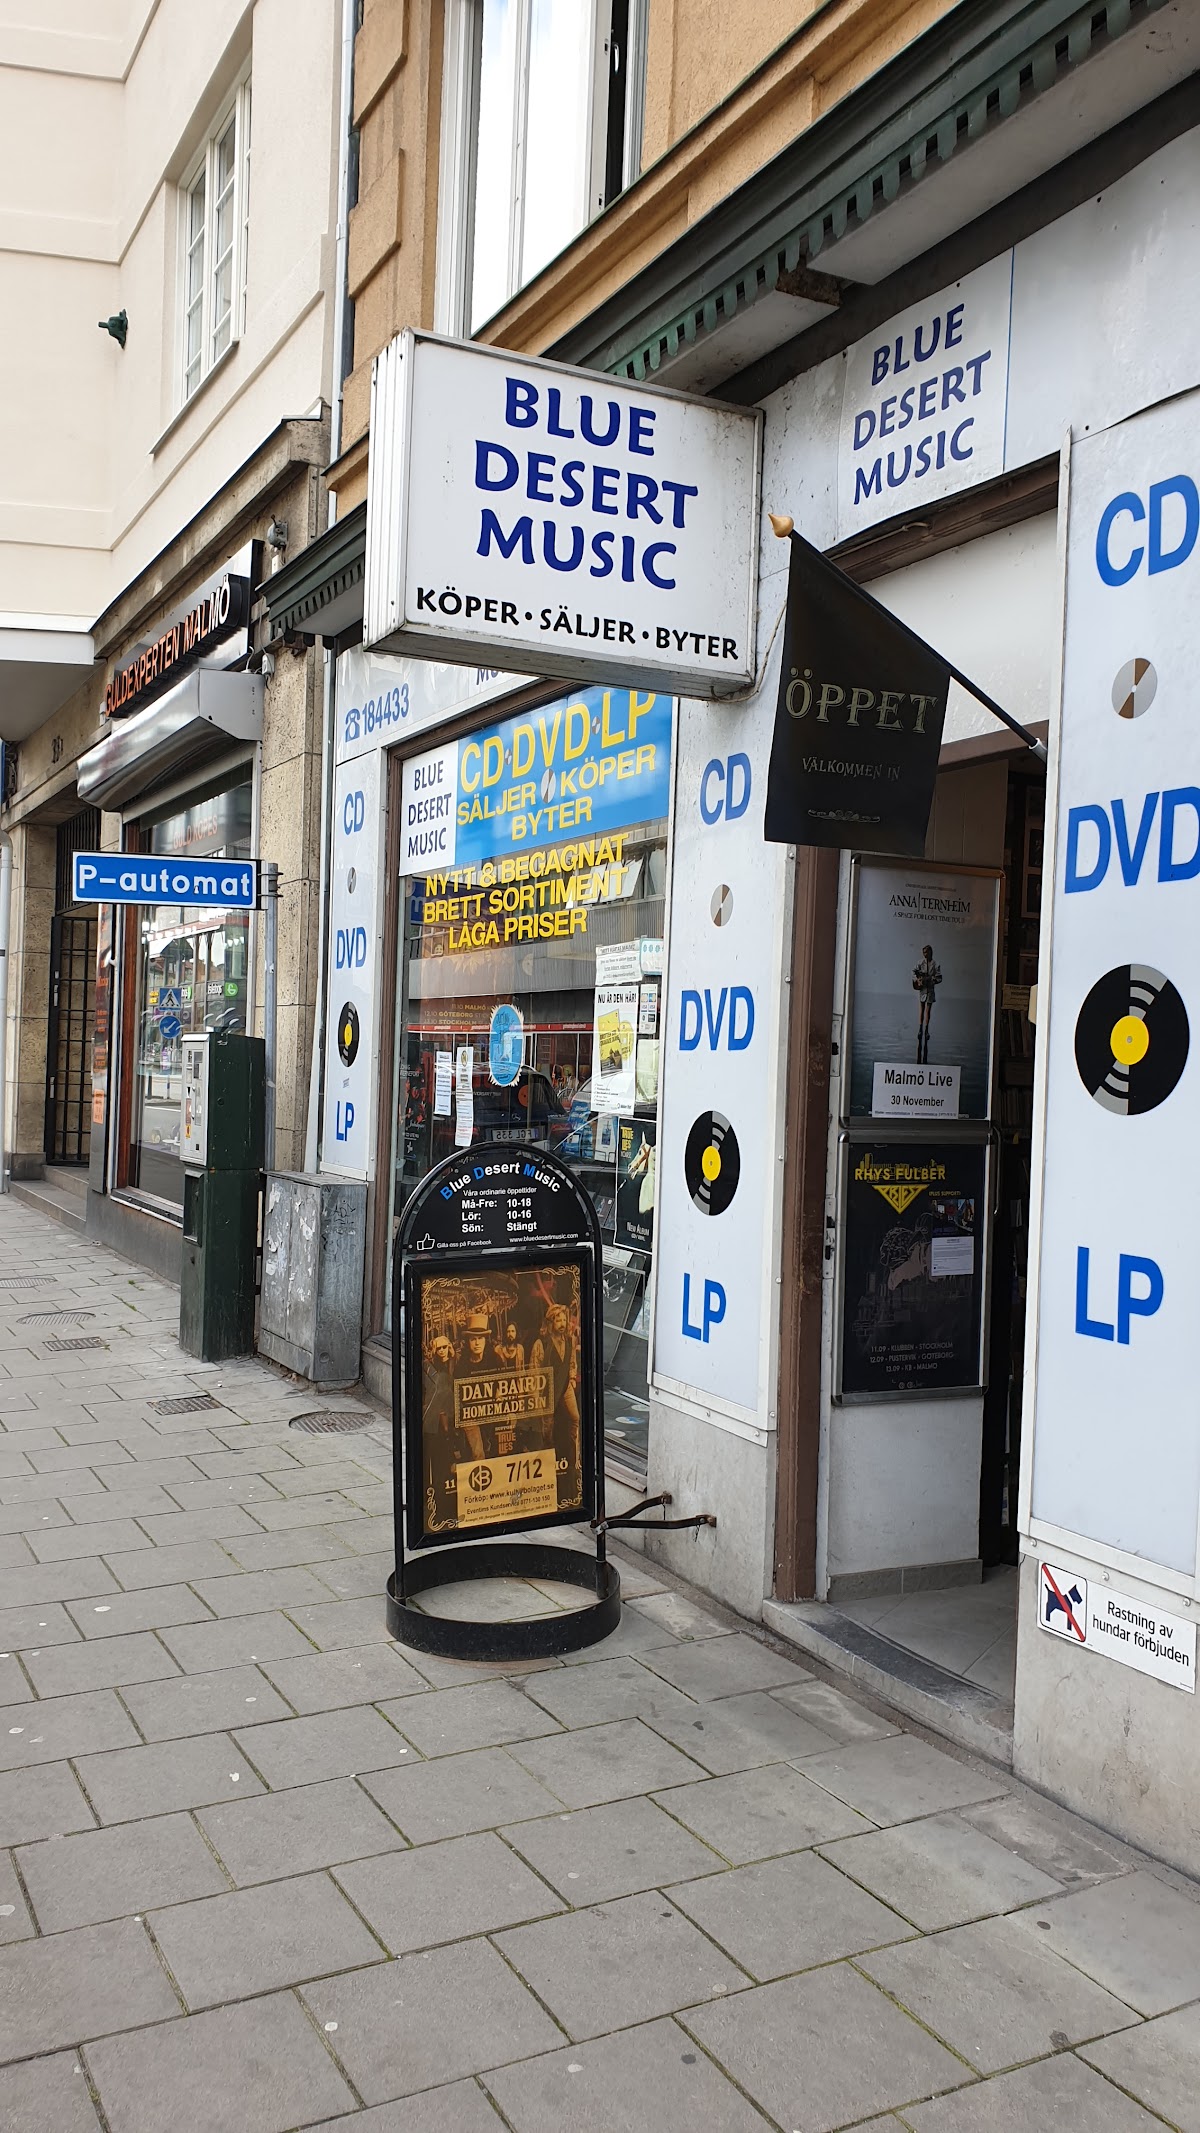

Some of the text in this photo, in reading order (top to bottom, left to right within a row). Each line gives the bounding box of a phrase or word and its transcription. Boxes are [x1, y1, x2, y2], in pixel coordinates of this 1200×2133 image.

[871, 303, 965, 386] BLUE
[505, 377, 656, 456] BLUE
[853, 350, 991, 451] DESERT
[853, 417, 975, 505] MUSIC
[475, 439, 698, 529] DESERT
[476, 509, 677, 590] MUSIC
[1096, 474, 1199, 587] CD
[416, 586, 739, 660] KÖPER SÄLJER BYTER
[105, 573, 231, 717] GULDEXPERTEN MALMÖ
[362, 682, 410, 736] 184433
[785, 667, 937, 734] ÖPPET
[461, 690, 656, 793] CD DVD LP
[413, 760, 444, 791] BLUE
[457, 744, 656, 826] SÄLJER KÖPER
[700, 752, 752, 826] CD
[802, 756, 900, 781] VÄLKOMMEN IN
[343, 790, 365, 836] CD
[408, 793, 451, 826] DESERT
[512, 796, 593, 840] BYTER
[408, 828, 447, 857] MUSIC
[1064, 786, 1200, 894] DVD
[79, 864, 250, 897] P-automat
[426, 834, 629, 897] NYTT & BEGAGNAT
[424, 867, 629, 923] BRETT SORTIMENT
[889, 894, 971, 913] ANNA TERNHEIM
[336, 926, 367, 970] DVD
[449, 908, 588, 948] LÅGA PRISER
[597, 993, 606, 1003] NU
[613, 993, 624, 1003] DEN
[678, 986, 755, 1052] DVD
[884, 1069, 953, 1087] Malmö Live
[336, 1100, 355, 1142] LP
[891, 1095, 944, 1107] 30 November
[440, 1162, 561, 1200] Blue Desert Music
[463, 1188, 479, 1197] Våra
[479, 1187, 506, 1196] ordinarie
[854, 1168, 946, 1181] RHYS FULBER
[461, 1198, 532, 1210] Må-Fre: 10-18
[461, 1210, 532, 1222] Lör: 10-16
[461, 1221, 538, 1234] Sön: Stängt
[508, 1232, 579, 1243] www.bluedesertmusic.com
[681, 1272, 727, 1344] LP
[1075, 1246, 1164, 1345] LP
[462, 1375, 547, 1402] DAN BAIRD
[462, 1396, 546, 1420] HOMEMADE SIN
[495, 1431, 516, 1442] TRUE
[470, 1466, 491, 1490] KB
[506, 1458, 542, 1483] 7/12
[464, 1493, 489, 1505] Förköp:
[1092, 1614, 1190, 1667] hundar förbjuden
[1107, 1600, 1174, 1639] Rastning av
